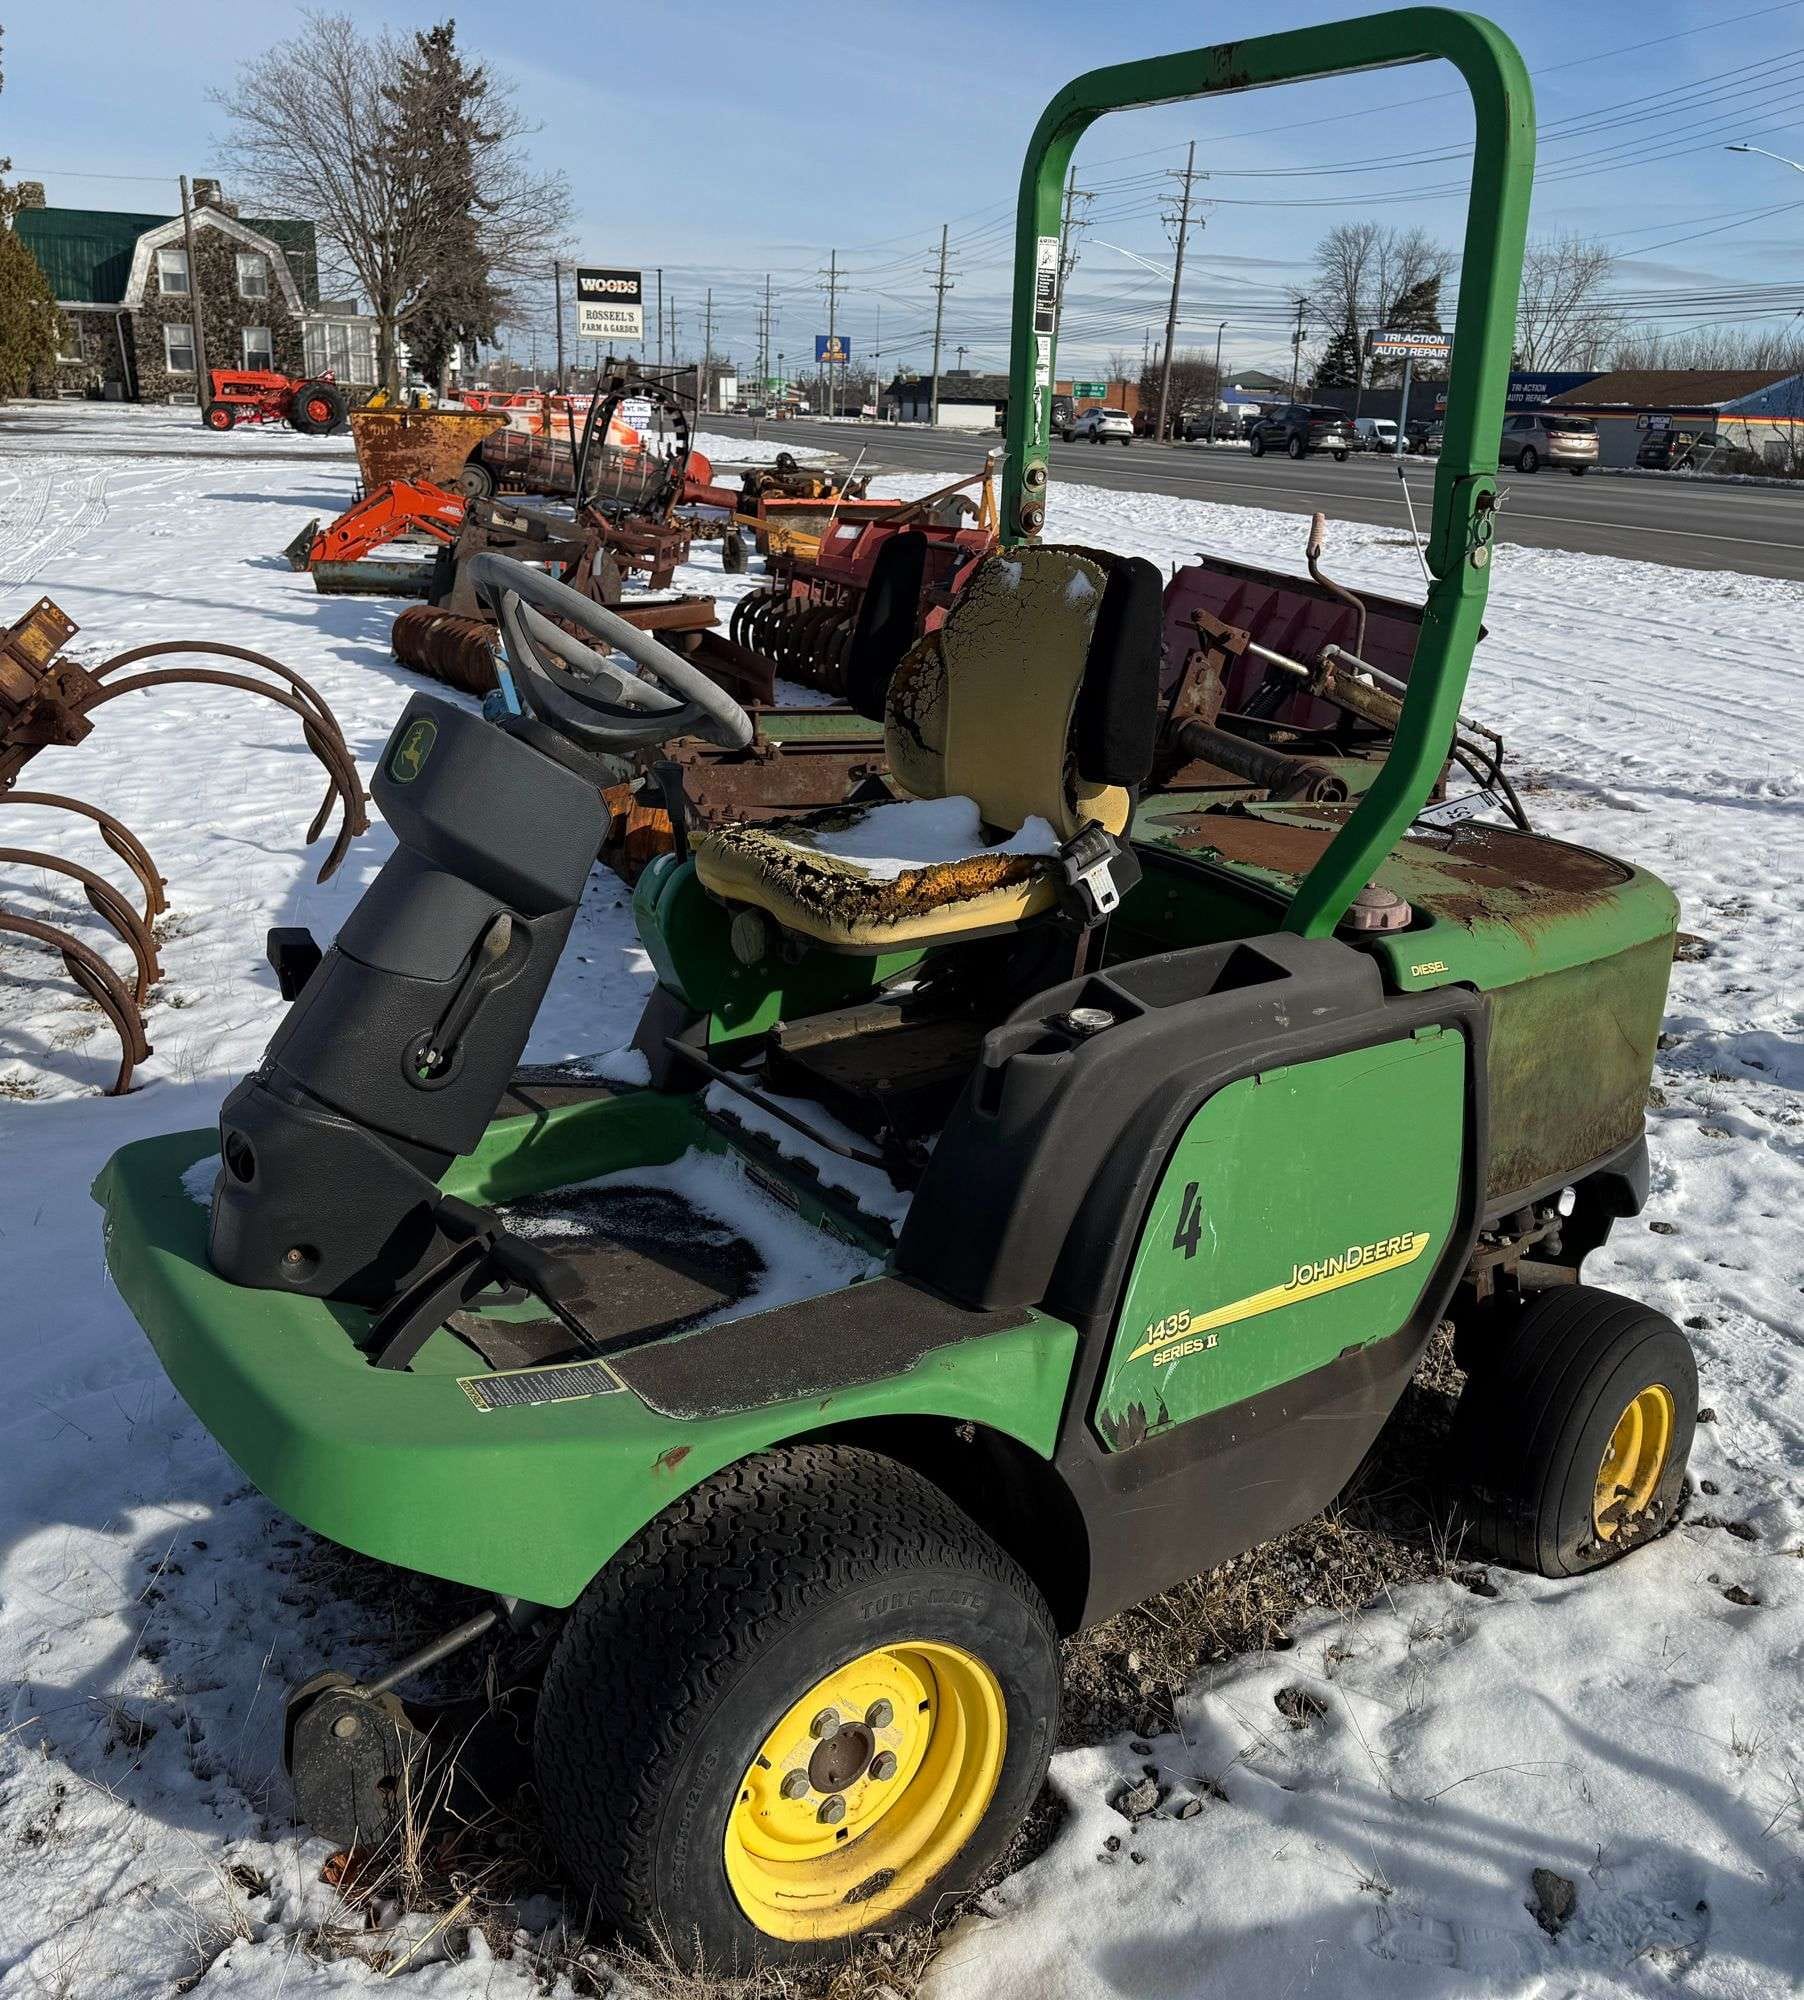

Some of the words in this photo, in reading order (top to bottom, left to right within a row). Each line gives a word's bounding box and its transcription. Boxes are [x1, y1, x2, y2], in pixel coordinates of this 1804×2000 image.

[580, 278, 638, 294] WOODS
[581, 323, 602, 332] FARM
[603, 324, 609, 332] &
[610, 324, 639, 334] GARDEN
[1383, 333, 1446, 345] TRI-ACTION
[1374, 346, 1407, 356] AUTO
[1409, 347, 1449, 358] REPAIR
[1511, 383, 1547, 392] TRI-ACTION
[1507, 393, 1524, 402] AUTO
[1411, 961, 1449, 976] DIESEL
[1171, 1182, 1202, 1261] 4
[1284, 1258, 1345, 1291] JOHN
[1345, 1231, 1415, 1271] DEERE
[1146, 1309, 1192, 1344] 1435
[1152, 1339, 1204, 1367] SERIES
